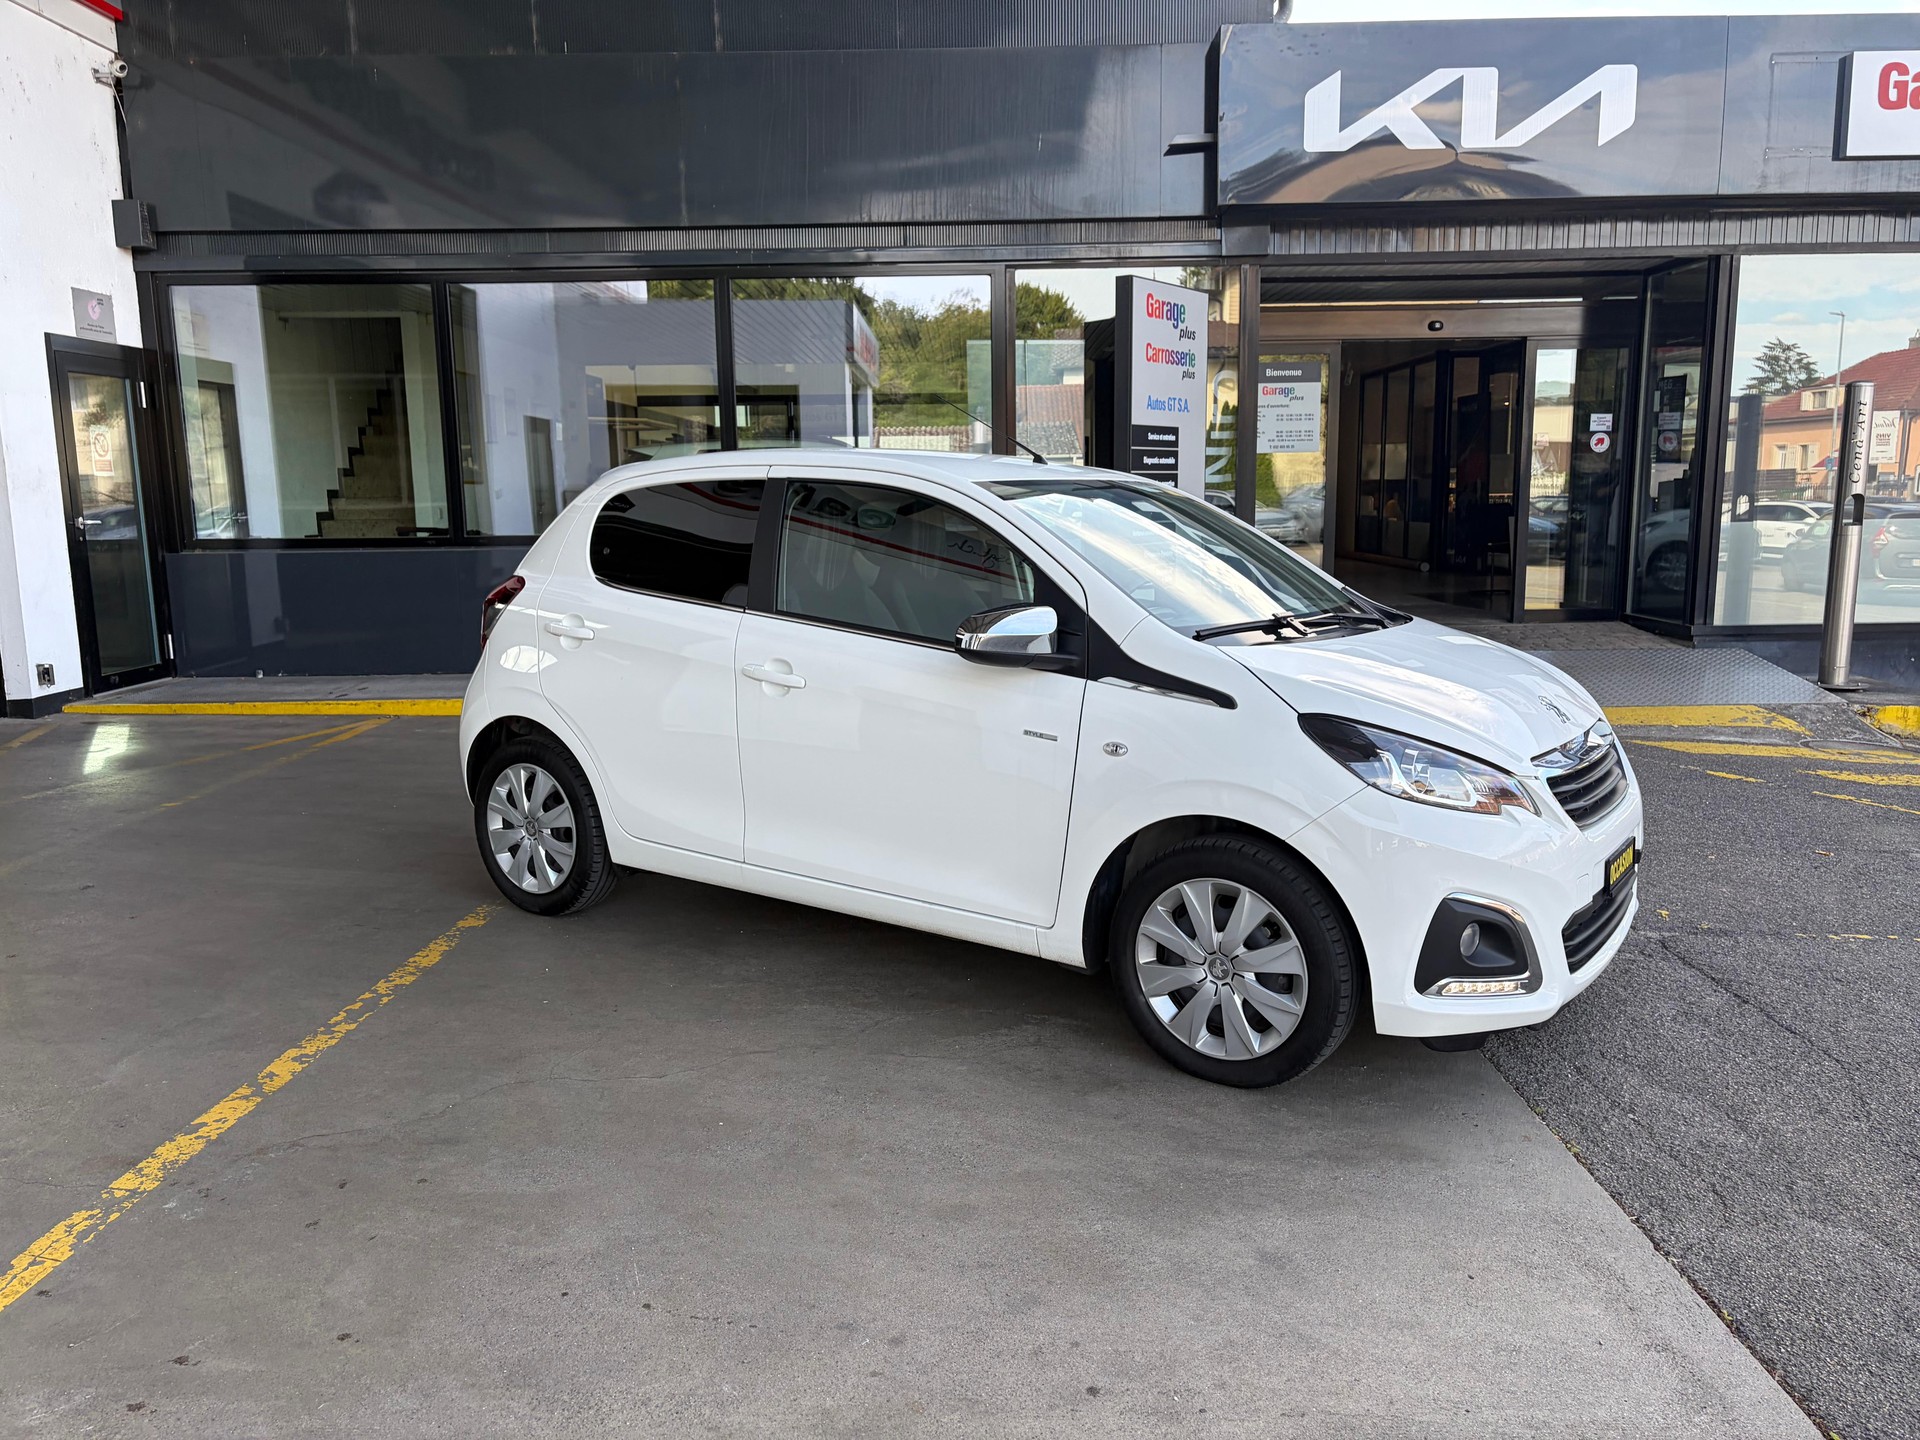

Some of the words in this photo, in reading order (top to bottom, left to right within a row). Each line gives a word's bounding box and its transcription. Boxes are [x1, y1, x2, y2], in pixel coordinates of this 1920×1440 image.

[1304, 64, 1638, 152] KIA
[1146, 292, 1186, 329] Garage
[1179, 326, 1197, 341] plus
[1145, 342, 1196, 368] Carrosserie
[1182, 369, 1195, 381] plus
[1266, 368, 1303, 377] Bienvenue
[1262, 385, 1295, 398] Garage
[1146, 395, 1166, 411] Autos
[1167, 397, 1177, 412] GT
[1178, 398, 1190, 413] S.A.
[1023, 730, 1043, 739] STYLE
[1609, 844, 1634, 885] OCCASION
